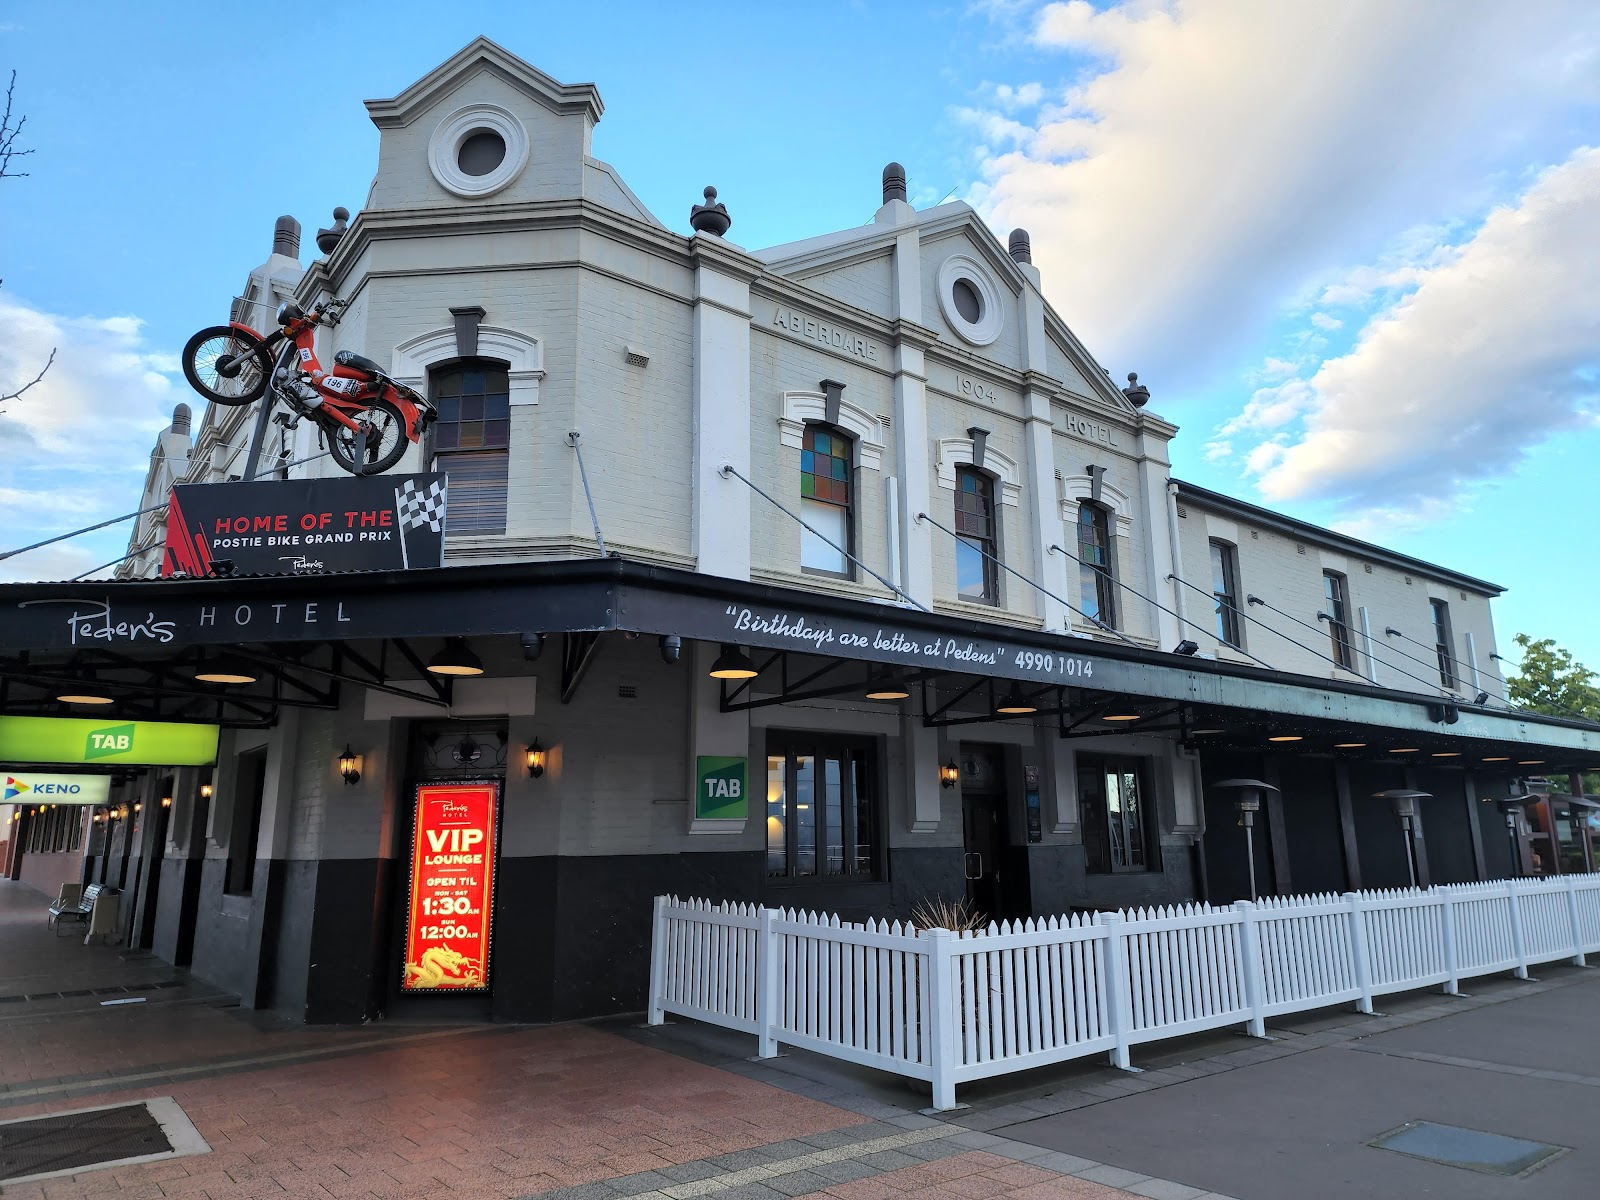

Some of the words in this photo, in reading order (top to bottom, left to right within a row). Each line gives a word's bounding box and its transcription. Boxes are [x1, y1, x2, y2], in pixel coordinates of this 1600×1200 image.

[774, 307, 878, 362] ABERDARE
[327, 377, 343, 388] 196
[956, 375, 997, 404] 1904
[1066, 413, 1118, 447] HOTEL
[215, 515, 288, 534] HOME
[300, 513, 333, 530] OF
[345, 510, 393, 528] THE
[213, 537, 262, 549] POSTIE
[267, 535, 300, 546] BIKE
[305, 533, 354, 545] GRAND
[359, 530, 392, 542] PRIX
[18, 596, 176, 645] Peden's
[200, 602, 351, 626] HOTEL
[725, 605, 836, 649] "Birthdays
[839, 633, 869, 648] are
[873, 630, 919, 655] better
[923, 642, 941, 657] at
[944, 639, 1005, 666] Pedens"
[1015, 651, 1052, 673] 4990
[1058, 656, 1093, 678] 1014
[92, 734, 130, 751] TAB
[33, 783, 81, 795] KENO
[705, 779, 741, 798] TAB
[426, 828, 484, 853] VIP
[424, 854, 482, 865] LOUNGE
[426, 877, 457, 887] OPEN
[459, 877, 477, 886] TIL
